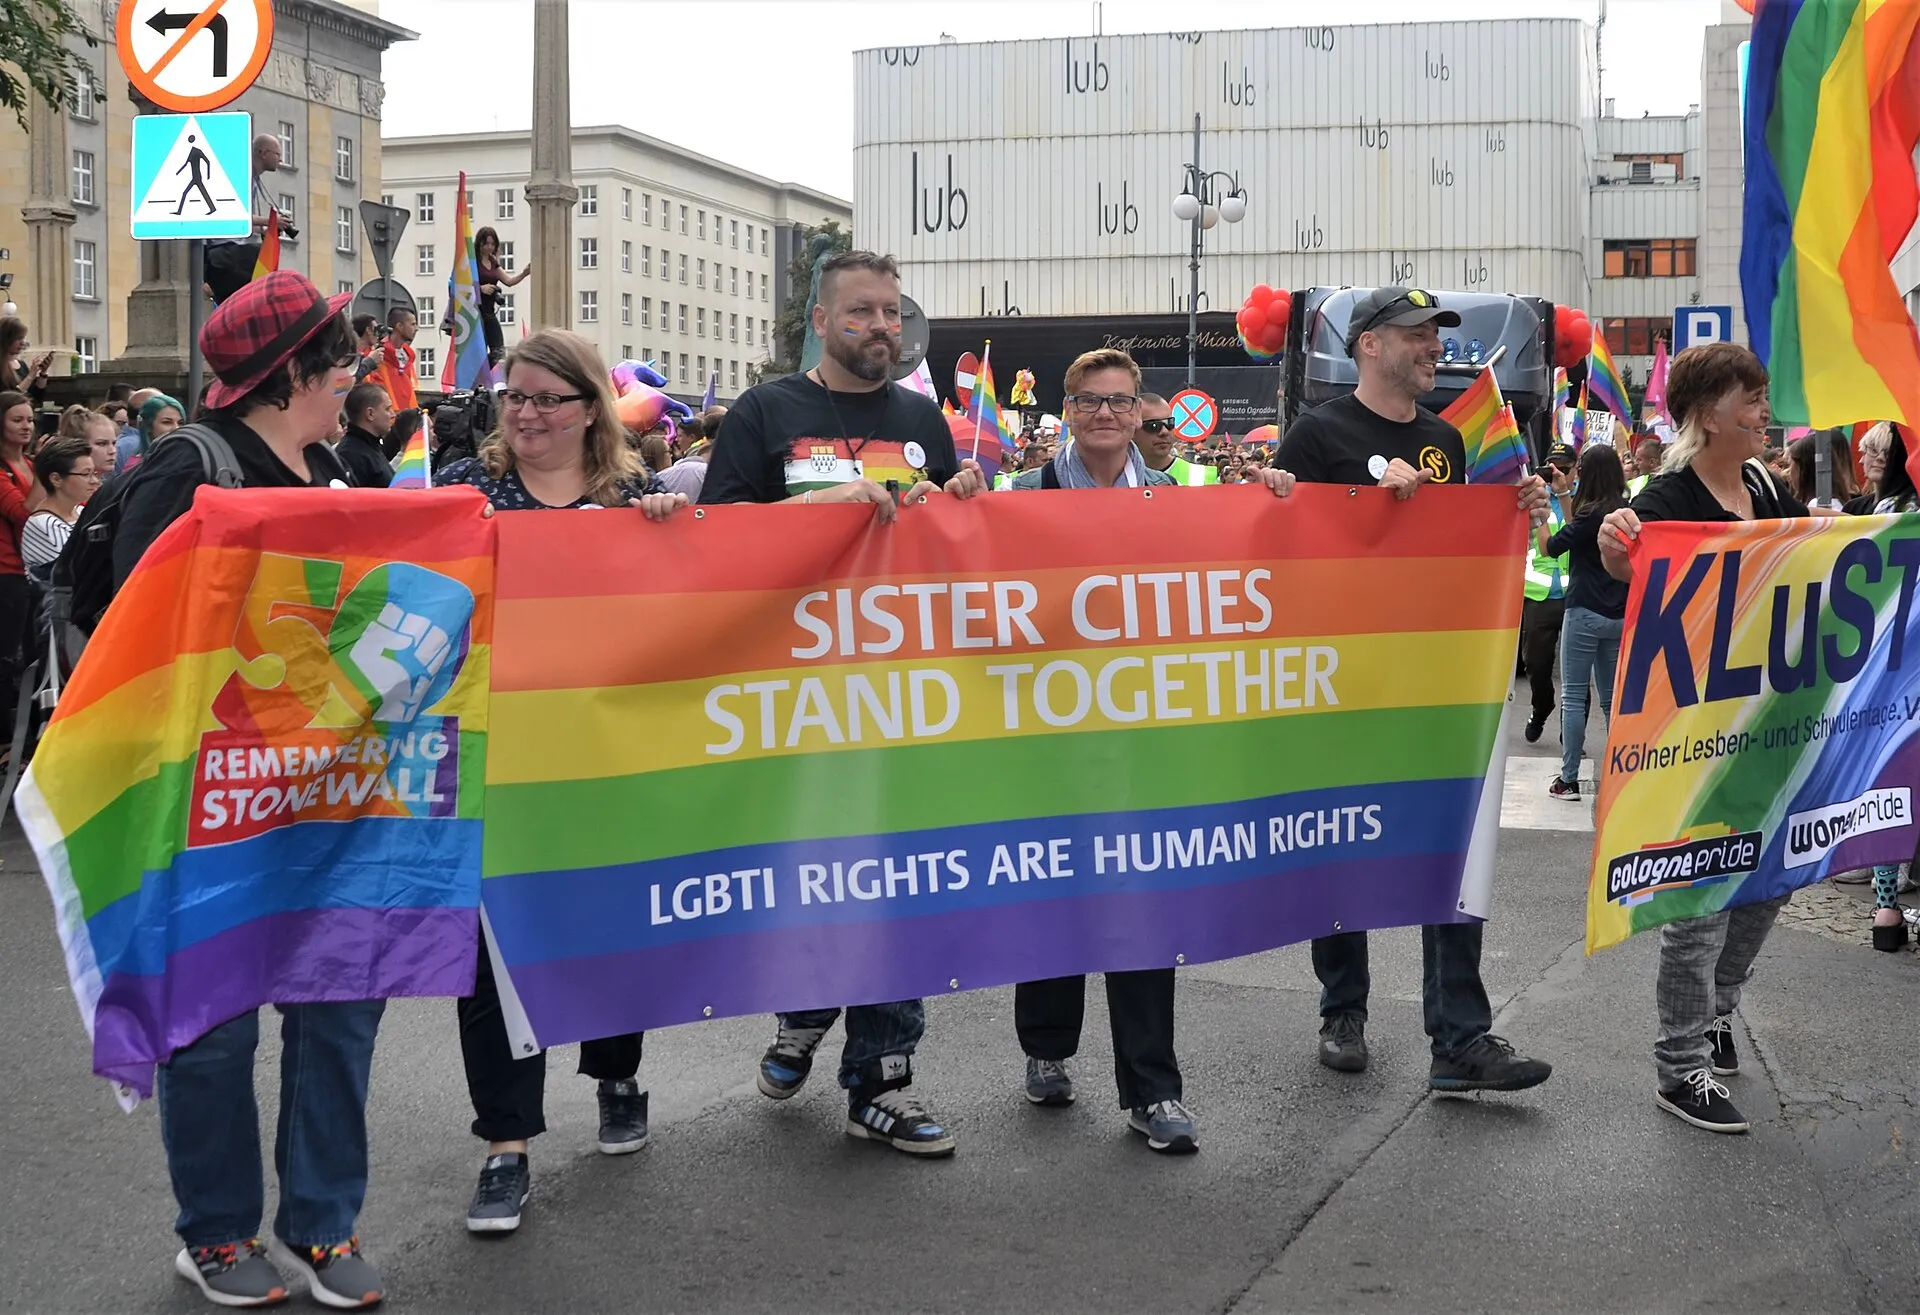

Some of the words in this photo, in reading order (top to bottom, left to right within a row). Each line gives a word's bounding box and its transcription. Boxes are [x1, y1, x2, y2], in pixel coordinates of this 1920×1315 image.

[1066, 38, 1109, 94] lub
[1223, 60, 1256, 106] lub
[1425, 50, 1449, 81] lub
[1359, 115, 1389, 150] lub
[1486, 129, 1506, 153] lub
[912, 151, 968, 236] lub
[1432, 157, 1454, 187] lub
[1098, 180, 1139, 236] lub
[1295, 214, 1323, 254] lub
[1464, 256, 1488, 287] lub
[1102, 333, 1182, 350] Katowice
[1222, 406, 1246, 414] Miasto
[791, 580, 1044, 659] SISTER
[1071, 568, 1273, 642] CITIES
[704, 669, 961, 755] STAND
[986, 645, 1340, 730] TOGETHER
[1610, 741, 1681, 776] Kölner
[1682, 729, 1758, 764] Lesben-
[1764, 718, 1799, 750] und
[201, 767, 445, 830] STONEWALL
[650, 867, 777, 926] LGBTI
[799, 849, 971, 907] RIGHTS
[987, 838, 1075, 886] ARE
[1094, 821, 1257, 875] HUMAN
[1268, 804, 1383, 856] RIGHTS
